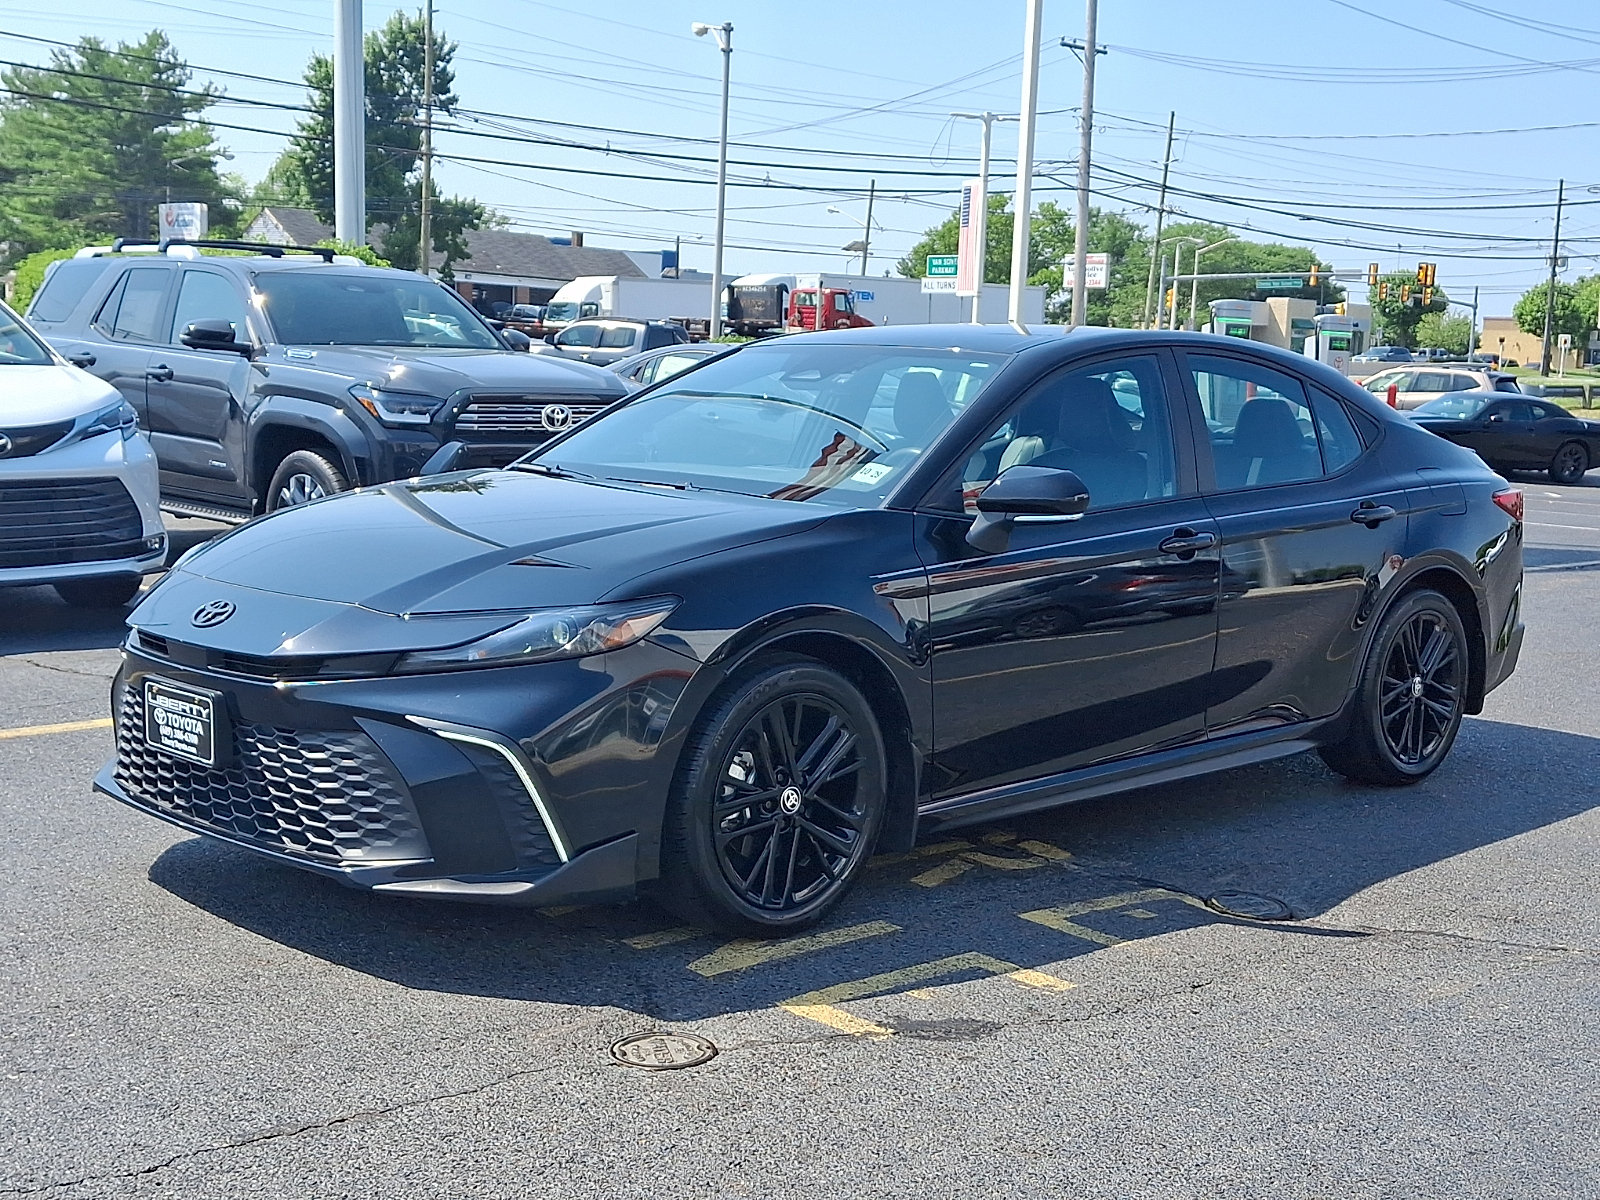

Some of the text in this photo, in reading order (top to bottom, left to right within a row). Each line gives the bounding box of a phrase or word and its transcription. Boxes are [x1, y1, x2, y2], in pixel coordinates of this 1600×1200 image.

[923, 281, 956, 290] ALL TURNS
[855, 290, 875, 301] TEN
[147, 691, 210, 719] LIBERTY
[166, 711, 205, 736] TOYOTA
